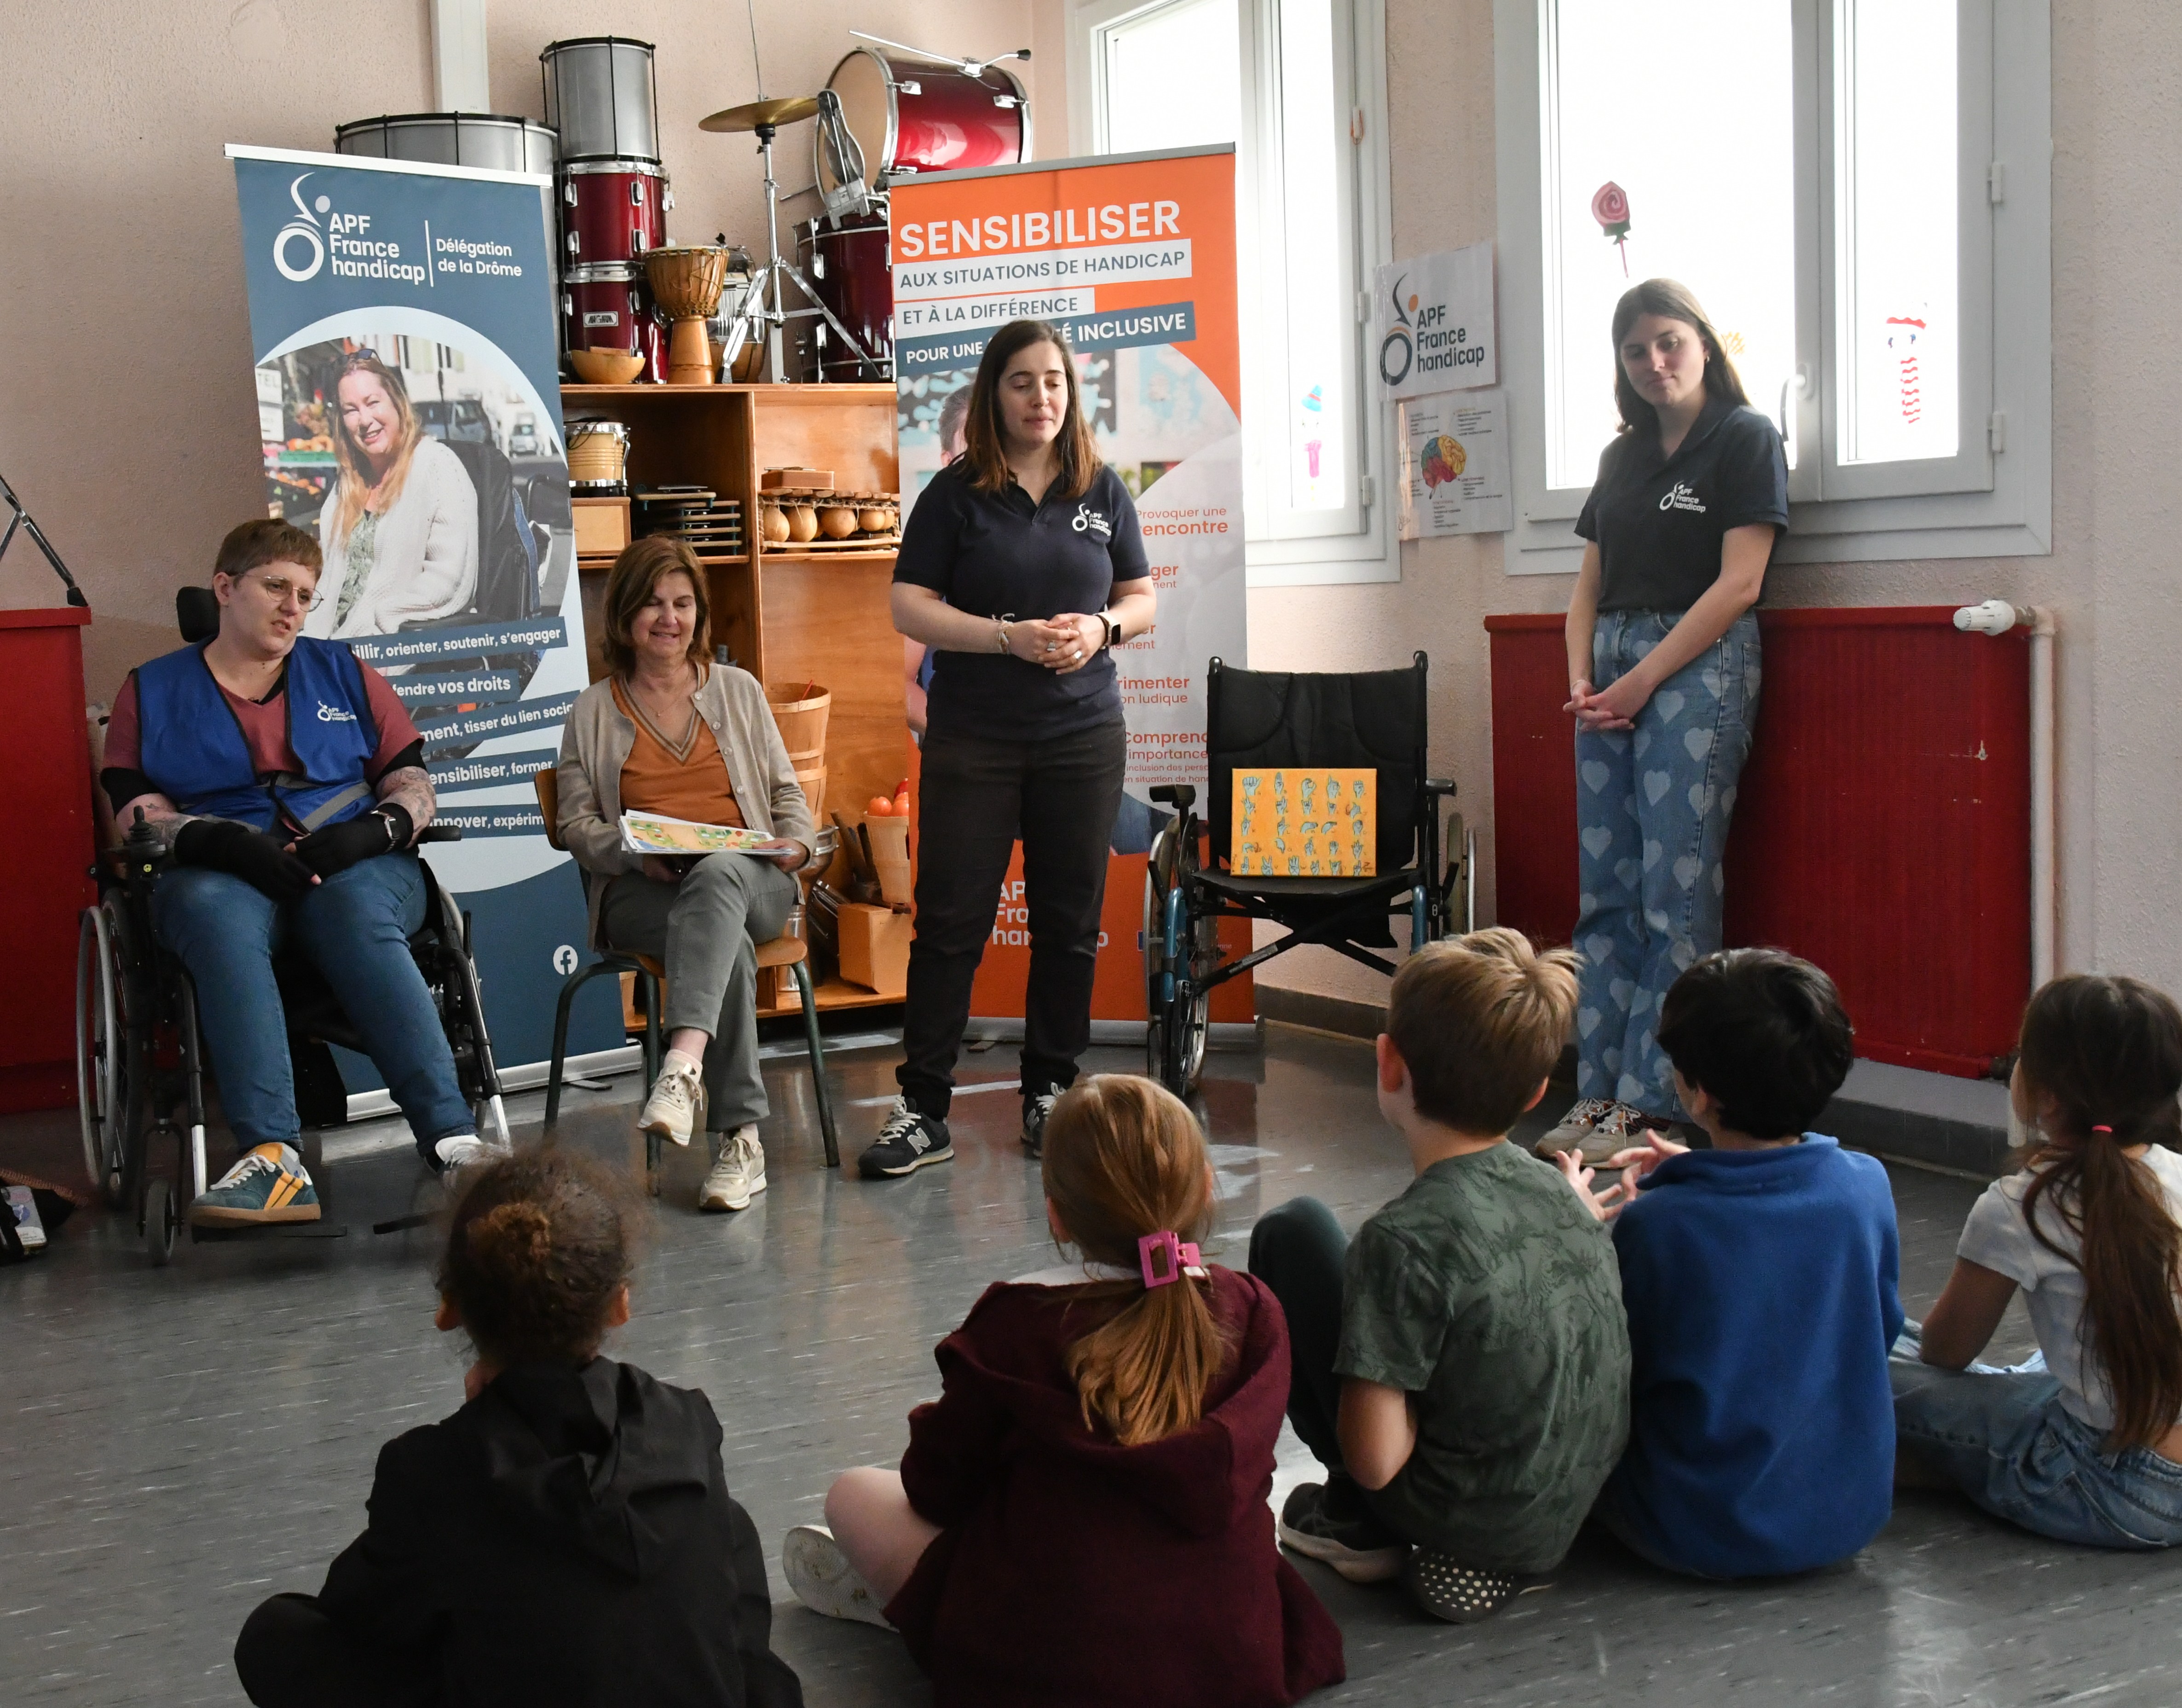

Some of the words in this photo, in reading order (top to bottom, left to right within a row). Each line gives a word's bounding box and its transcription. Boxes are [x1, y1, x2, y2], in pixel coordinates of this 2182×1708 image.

[329, 213, 371, 235] APF
[900, 200, 1181, 257] SENSIBILISER
[329, 234, 400, 258] France
[436, 237, 512, 258] Délégation
[331, 255, 426, 285] handicap
[438, 258, 456, 272] de
[459, 259, 473, 273] la
[475, 260, 522, 277] Drôme
[900, 271, 938, 289] AUX
[943, 262, 1051, 285] SITUATIONS
[1056, 260, 1079, 275] DE
[1084, 251, 1185, 273] HANDICAP
[903, 310, 923, 325] ET
[928, 305, 940, 323] À
[946, 306, 966, 322] LA
[971, 297, 1078, 319] DIFFÉRENCE
[1416, 305, 1446, 329] APF
[906, 346, 949, 364] POUR
[953, 341, 983, 358] UNE
[1078, 312, 1187, 342] INCLUSIVE
[1417, 327, 1466, 352] France
[1417, 346, 1484, 373] handicap
[1673, 501, 1706, 514] handicap
[1675, 494, 1699, 504] France
[1089, 518, 1109, 528] France
[1203, 508, 1227, 517] une
[1140, 520, 1229, 536] encontre
[352, 643, 384, 660] illir,
[386, 641, 442, 657] orienter,
[444, 633, 498, 651] soutenir,
[437, 681, 464, 694] vos
[467, 675, 511, 692] droits
[1139, 693, 1188, 706] ludique
[464, 718, 498, 734] tisser
[501, 714, 517, 727] du
[518, 710, 541, 723] lien
[510, 760, 553, 775] former
[1135, 775, 1173, 783] situation
[429, 815, 491, 829] nnover,
